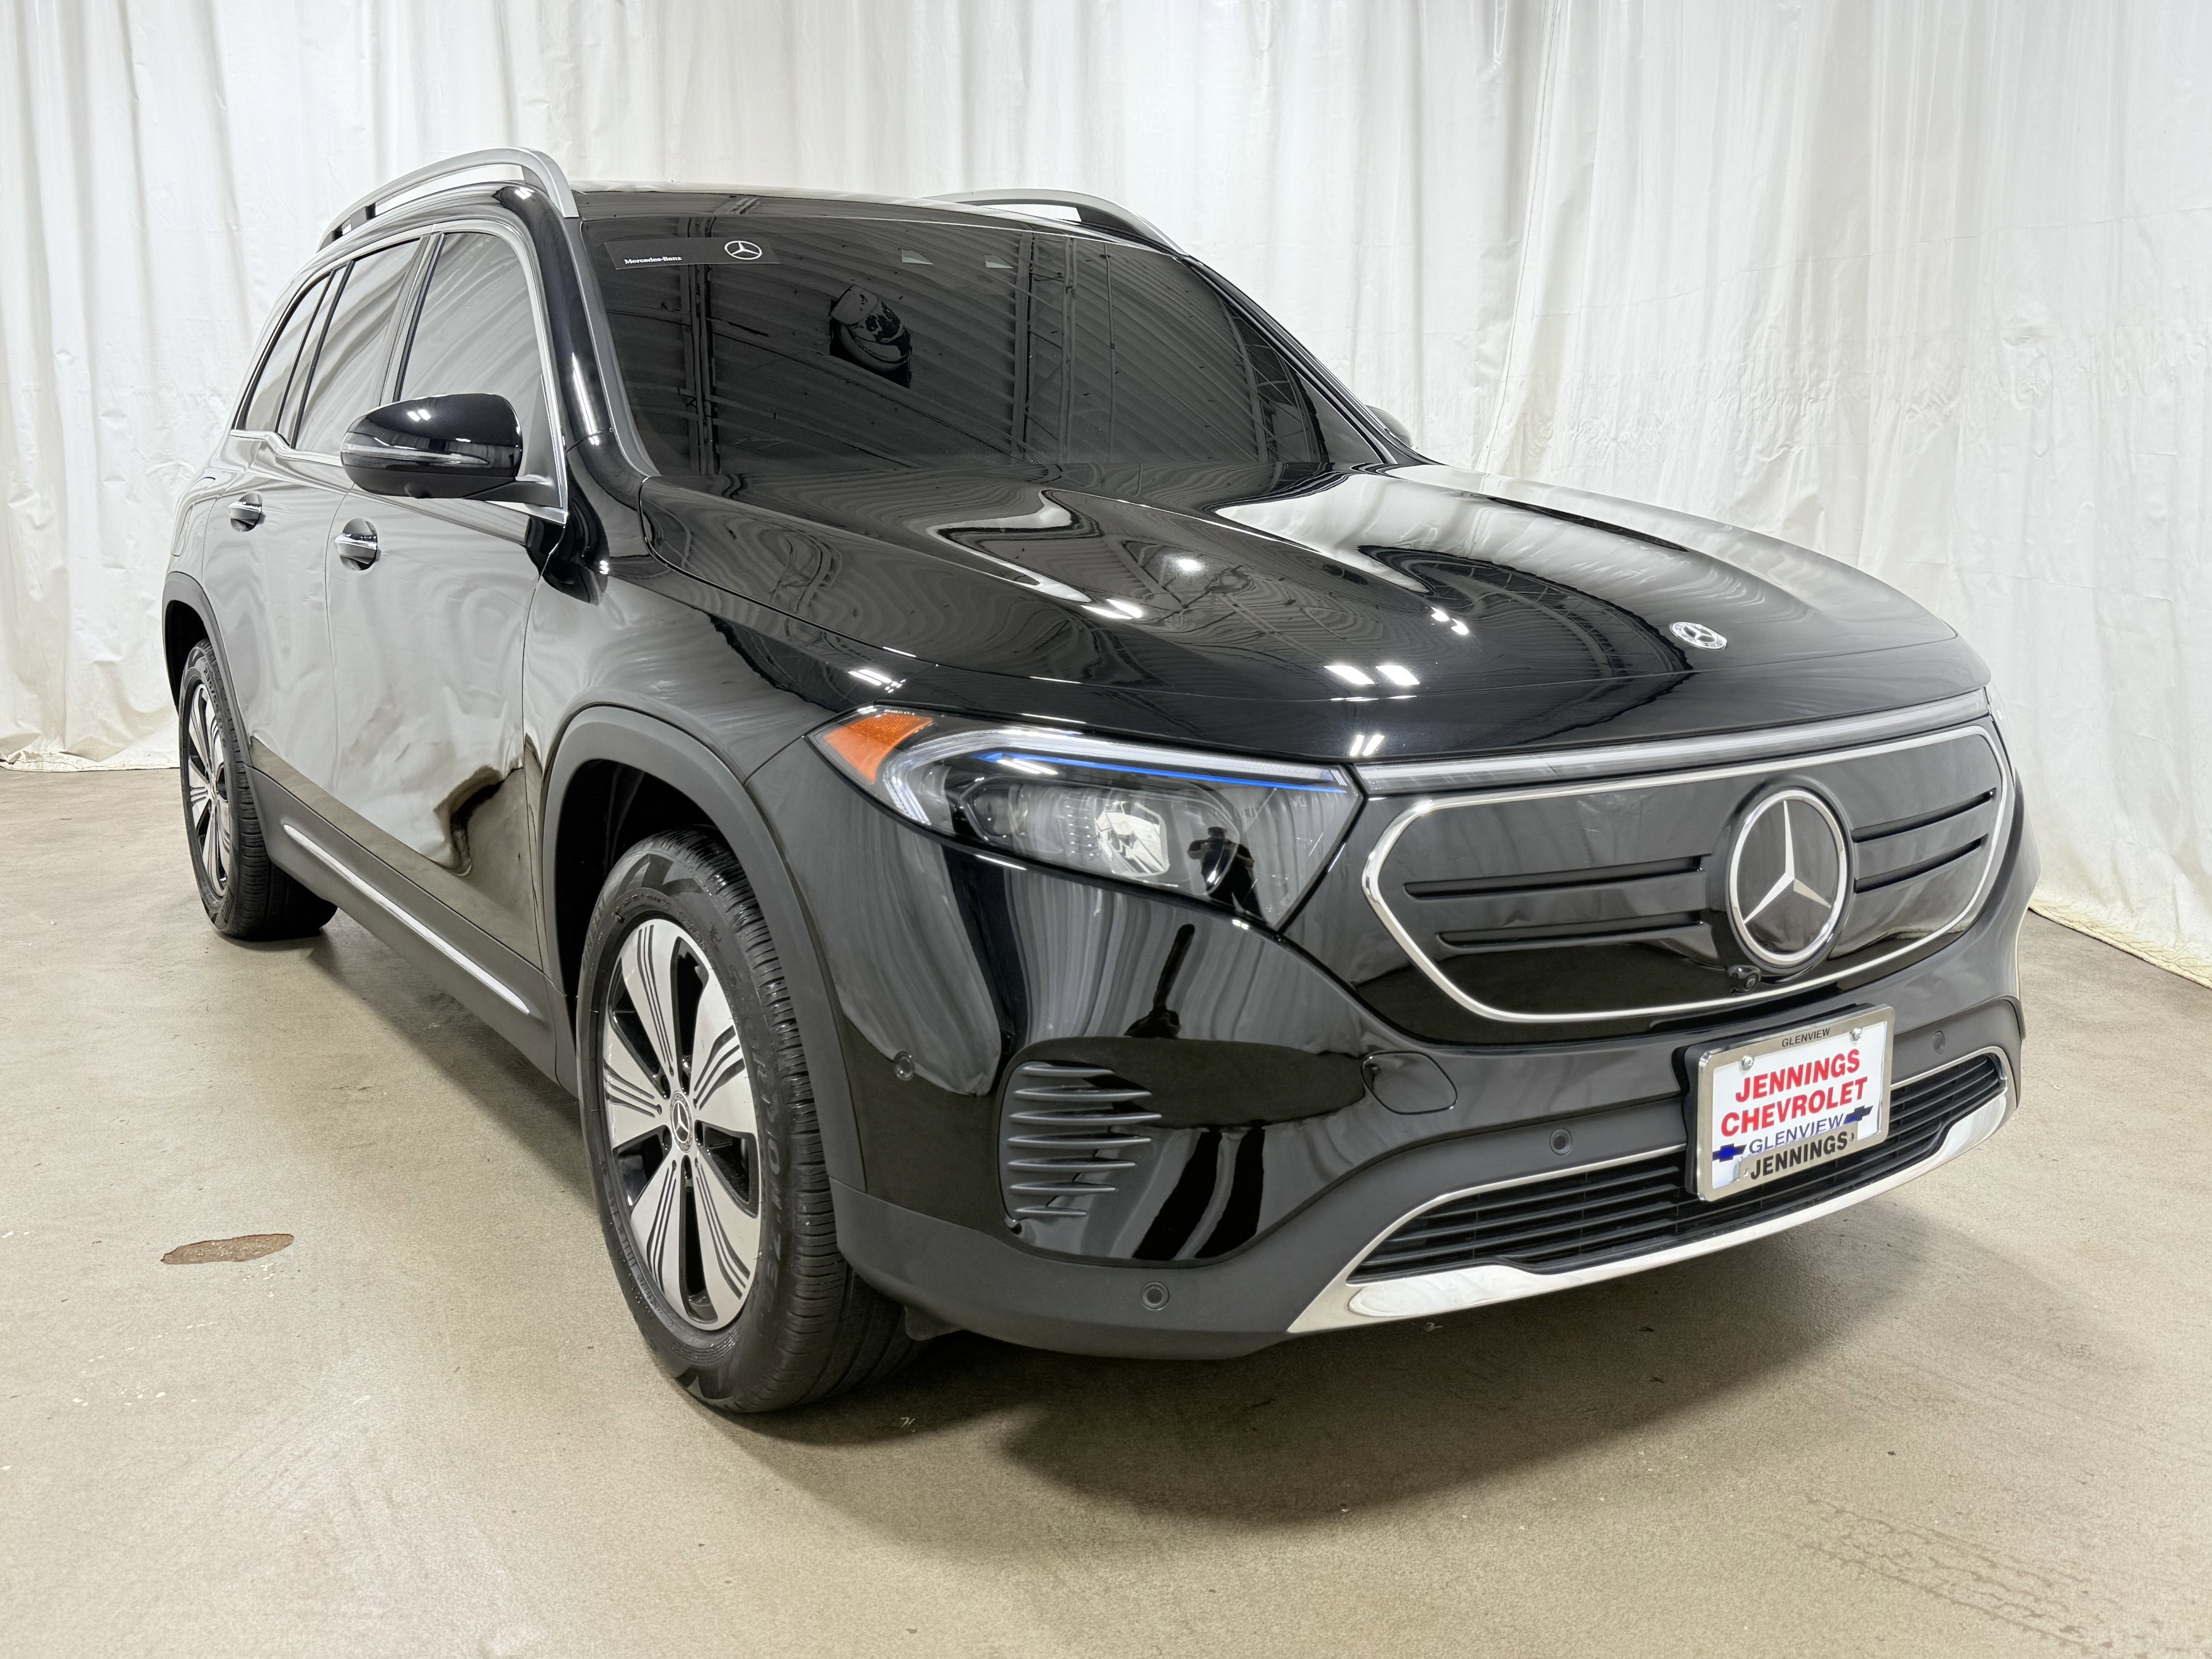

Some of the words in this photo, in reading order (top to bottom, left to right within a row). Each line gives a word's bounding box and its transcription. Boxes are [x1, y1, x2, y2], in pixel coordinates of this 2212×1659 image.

[1781, 1027, 1830, 1047] GLENVIEW
[1735, 1049, 1860, 1103] JENNINGS
[1721, 1076, 1868, 1137] CHEVROLET
[1749, 1113, 1844, 1154] GLENVIEW
[1750, 1131, 1848, 1180] JENNINGS
